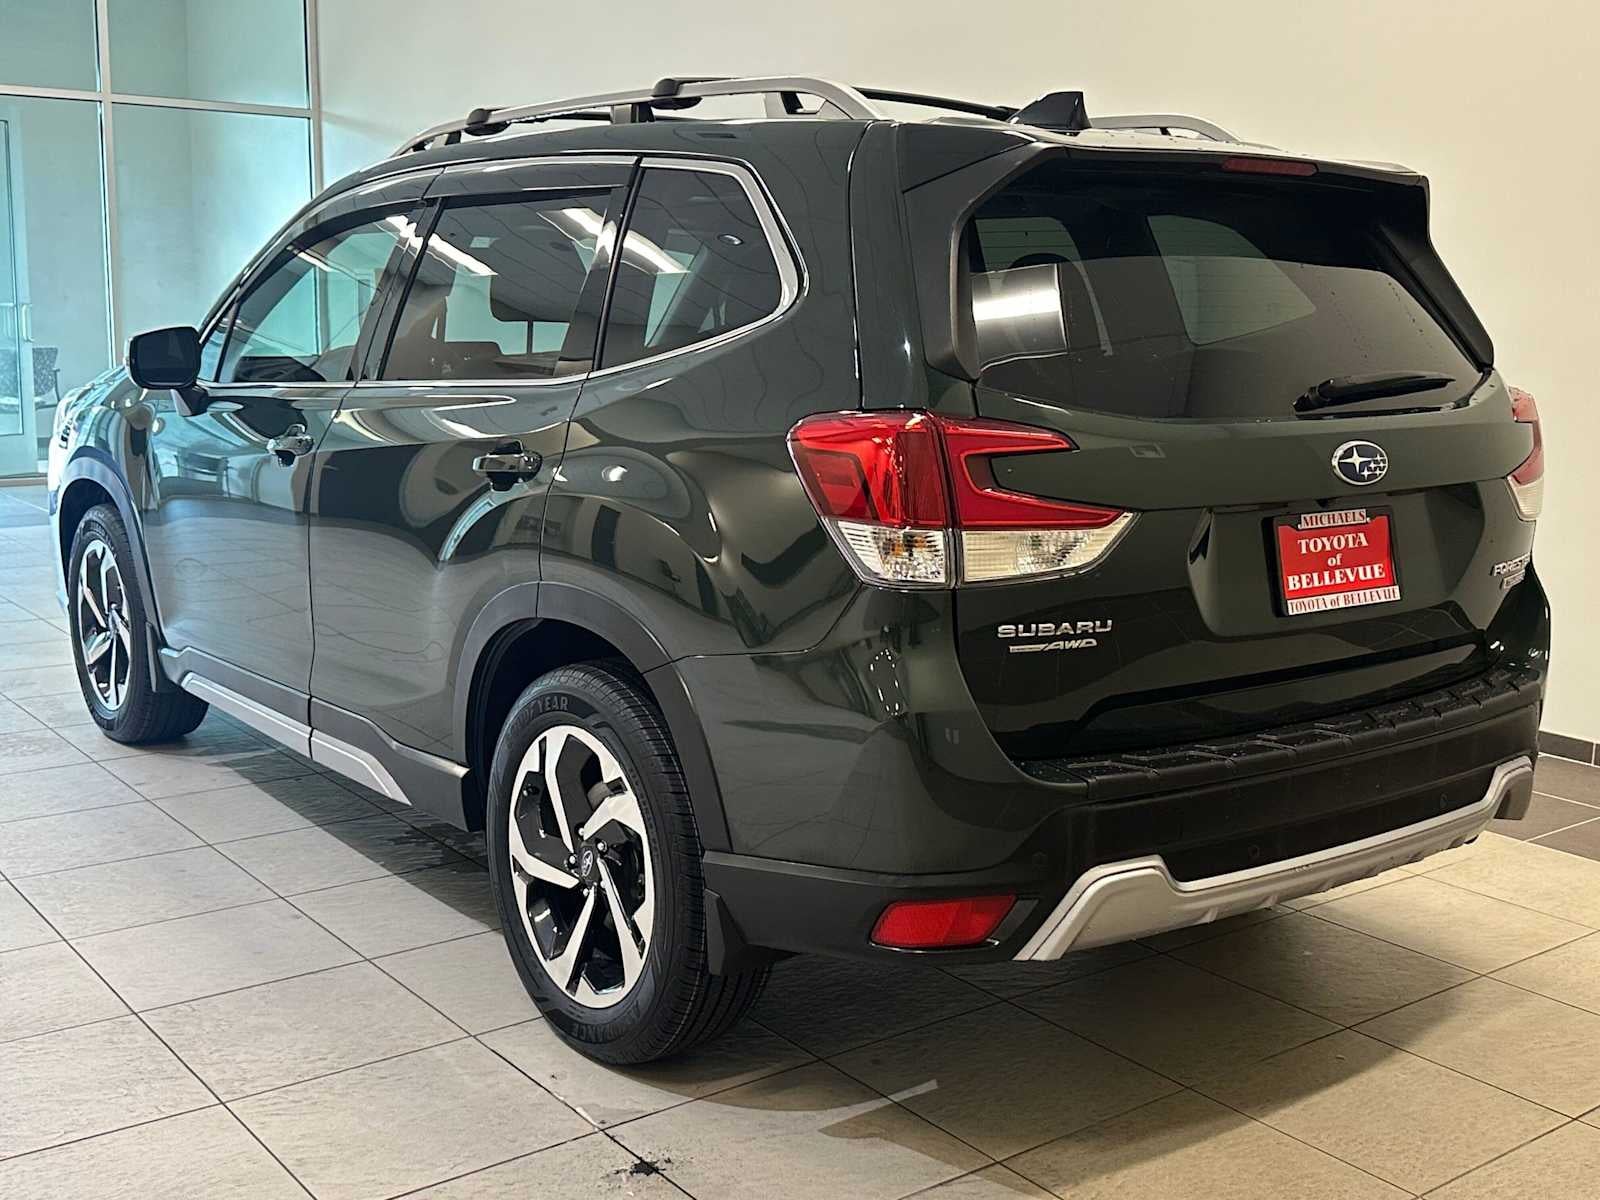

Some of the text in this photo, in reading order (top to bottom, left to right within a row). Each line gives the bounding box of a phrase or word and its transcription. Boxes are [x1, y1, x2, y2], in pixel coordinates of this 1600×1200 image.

[1302, 511, 1366, 527] MICHAELS
[1298, 533, 1369, 554] TOYOTA
[1327, 553, 1343, 567] of
[1287, 563, 1386, 591] BELLEVUE
[1289, 587, 1399, 613] TOYOTA of BELLEVUE
[997, 620, 1112, 638] SUBARU
[1043, 638, 1098, 651] AWD
